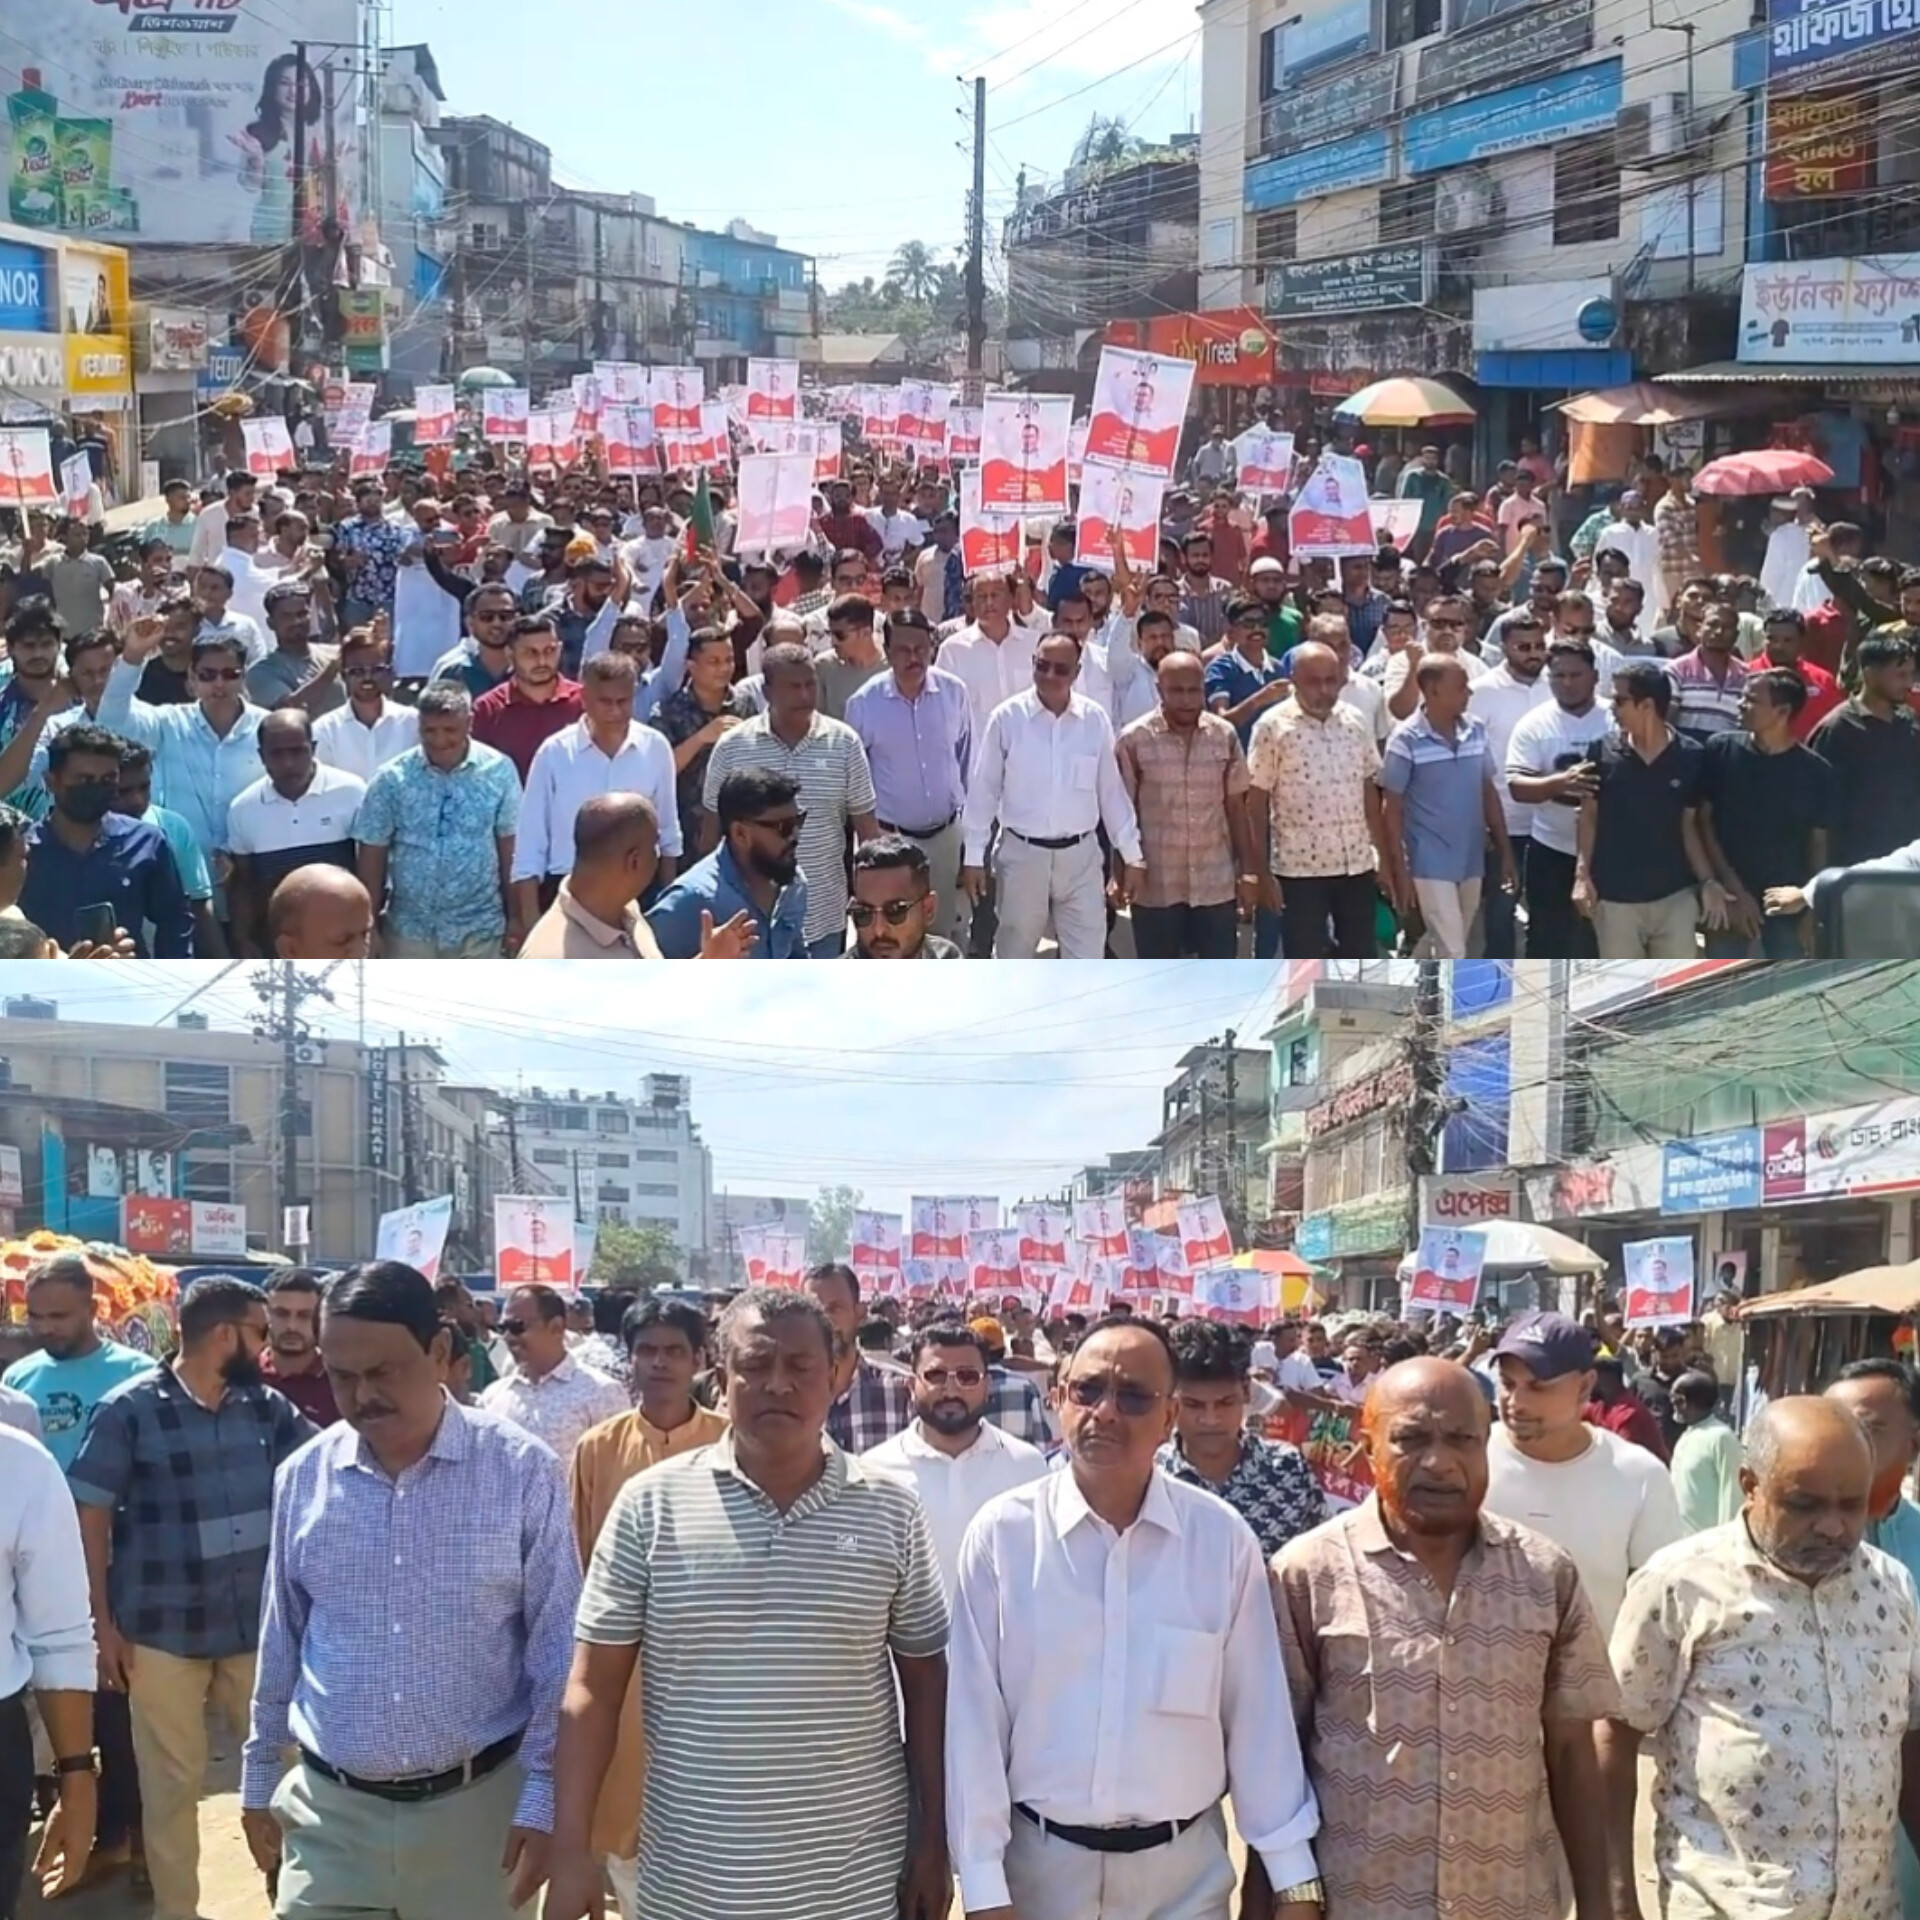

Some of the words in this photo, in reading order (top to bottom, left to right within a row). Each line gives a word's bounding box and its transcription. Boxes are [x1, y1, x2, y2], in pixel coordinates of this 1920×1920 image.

[1795, 167, 1837, 192] হল
[1754, 270, 1845, 315] ইউনিক
[1203, 337, 1238, 364] Treat
[372, 1050, 384, 1100] HOTEL
[1435, 1188, 1511, 1217] এপেক্স
